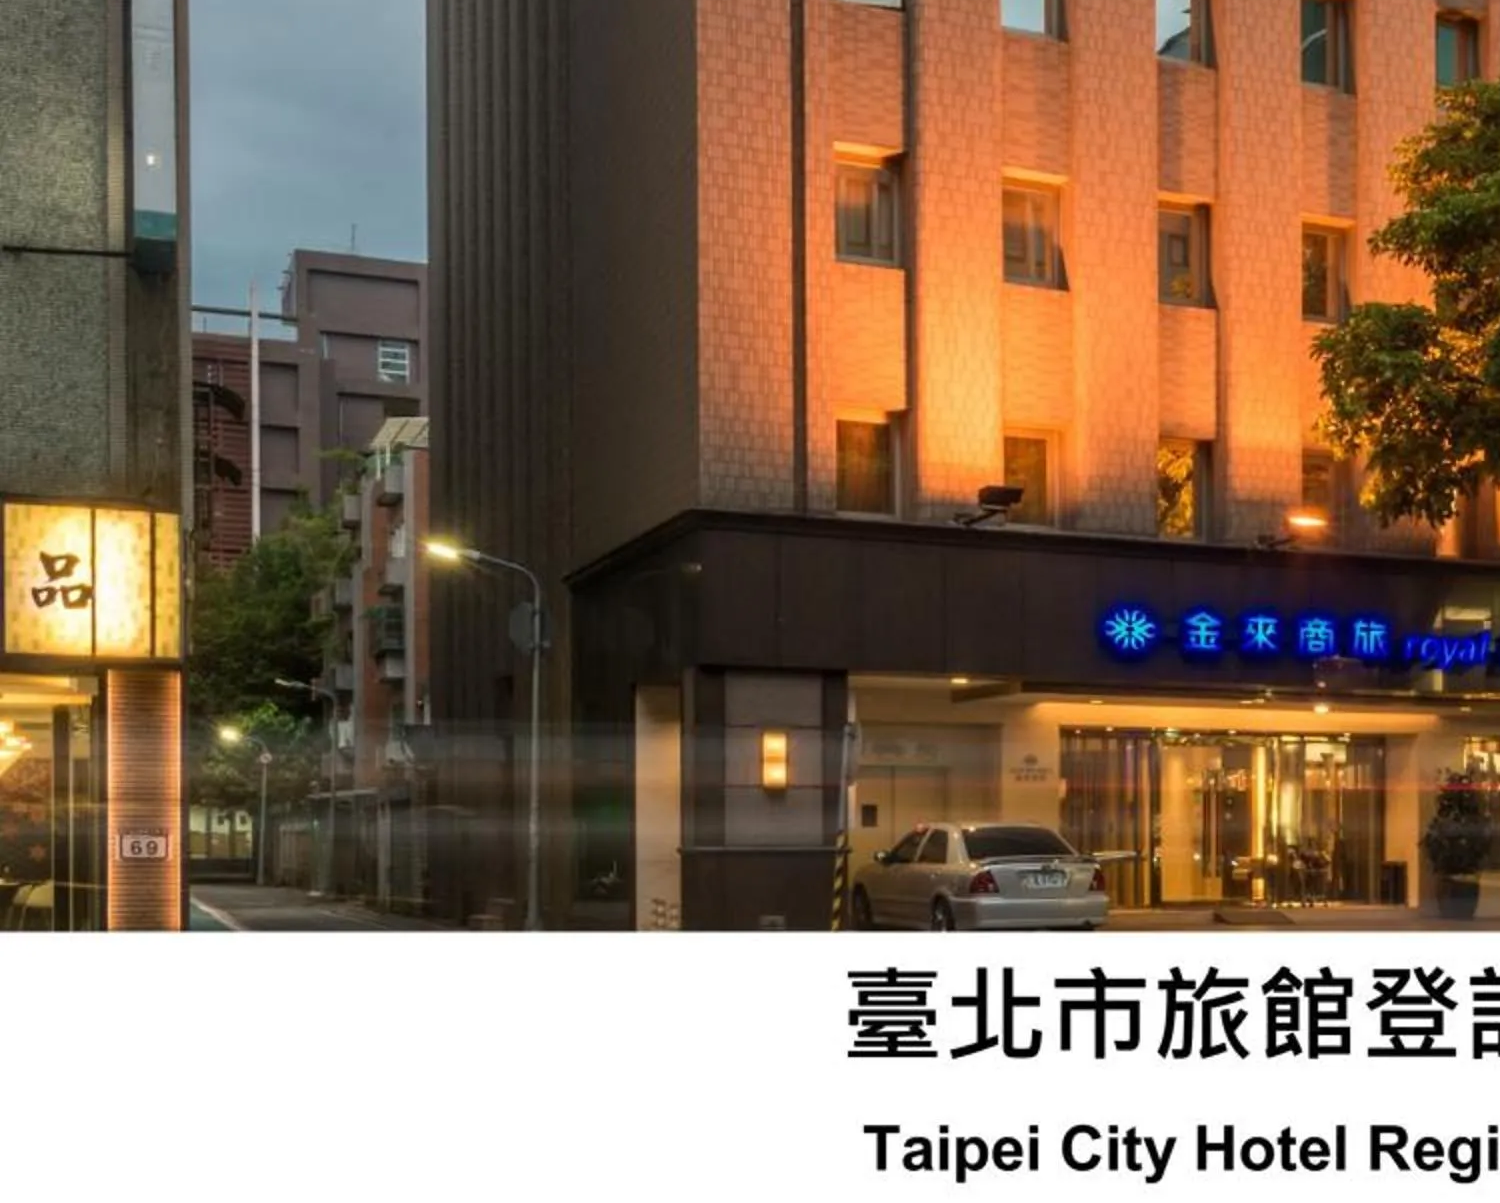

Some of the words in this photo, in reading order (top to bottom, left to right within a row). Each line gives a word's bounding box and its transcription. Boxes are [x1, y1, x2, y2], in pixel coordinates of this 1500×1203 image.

[31, 551, 94, 609] 品
[1184, 611, 1387, 654] 金來商旅
[1404, 630, 1490, 670] royal
[130, 840, 158, 856] 69
